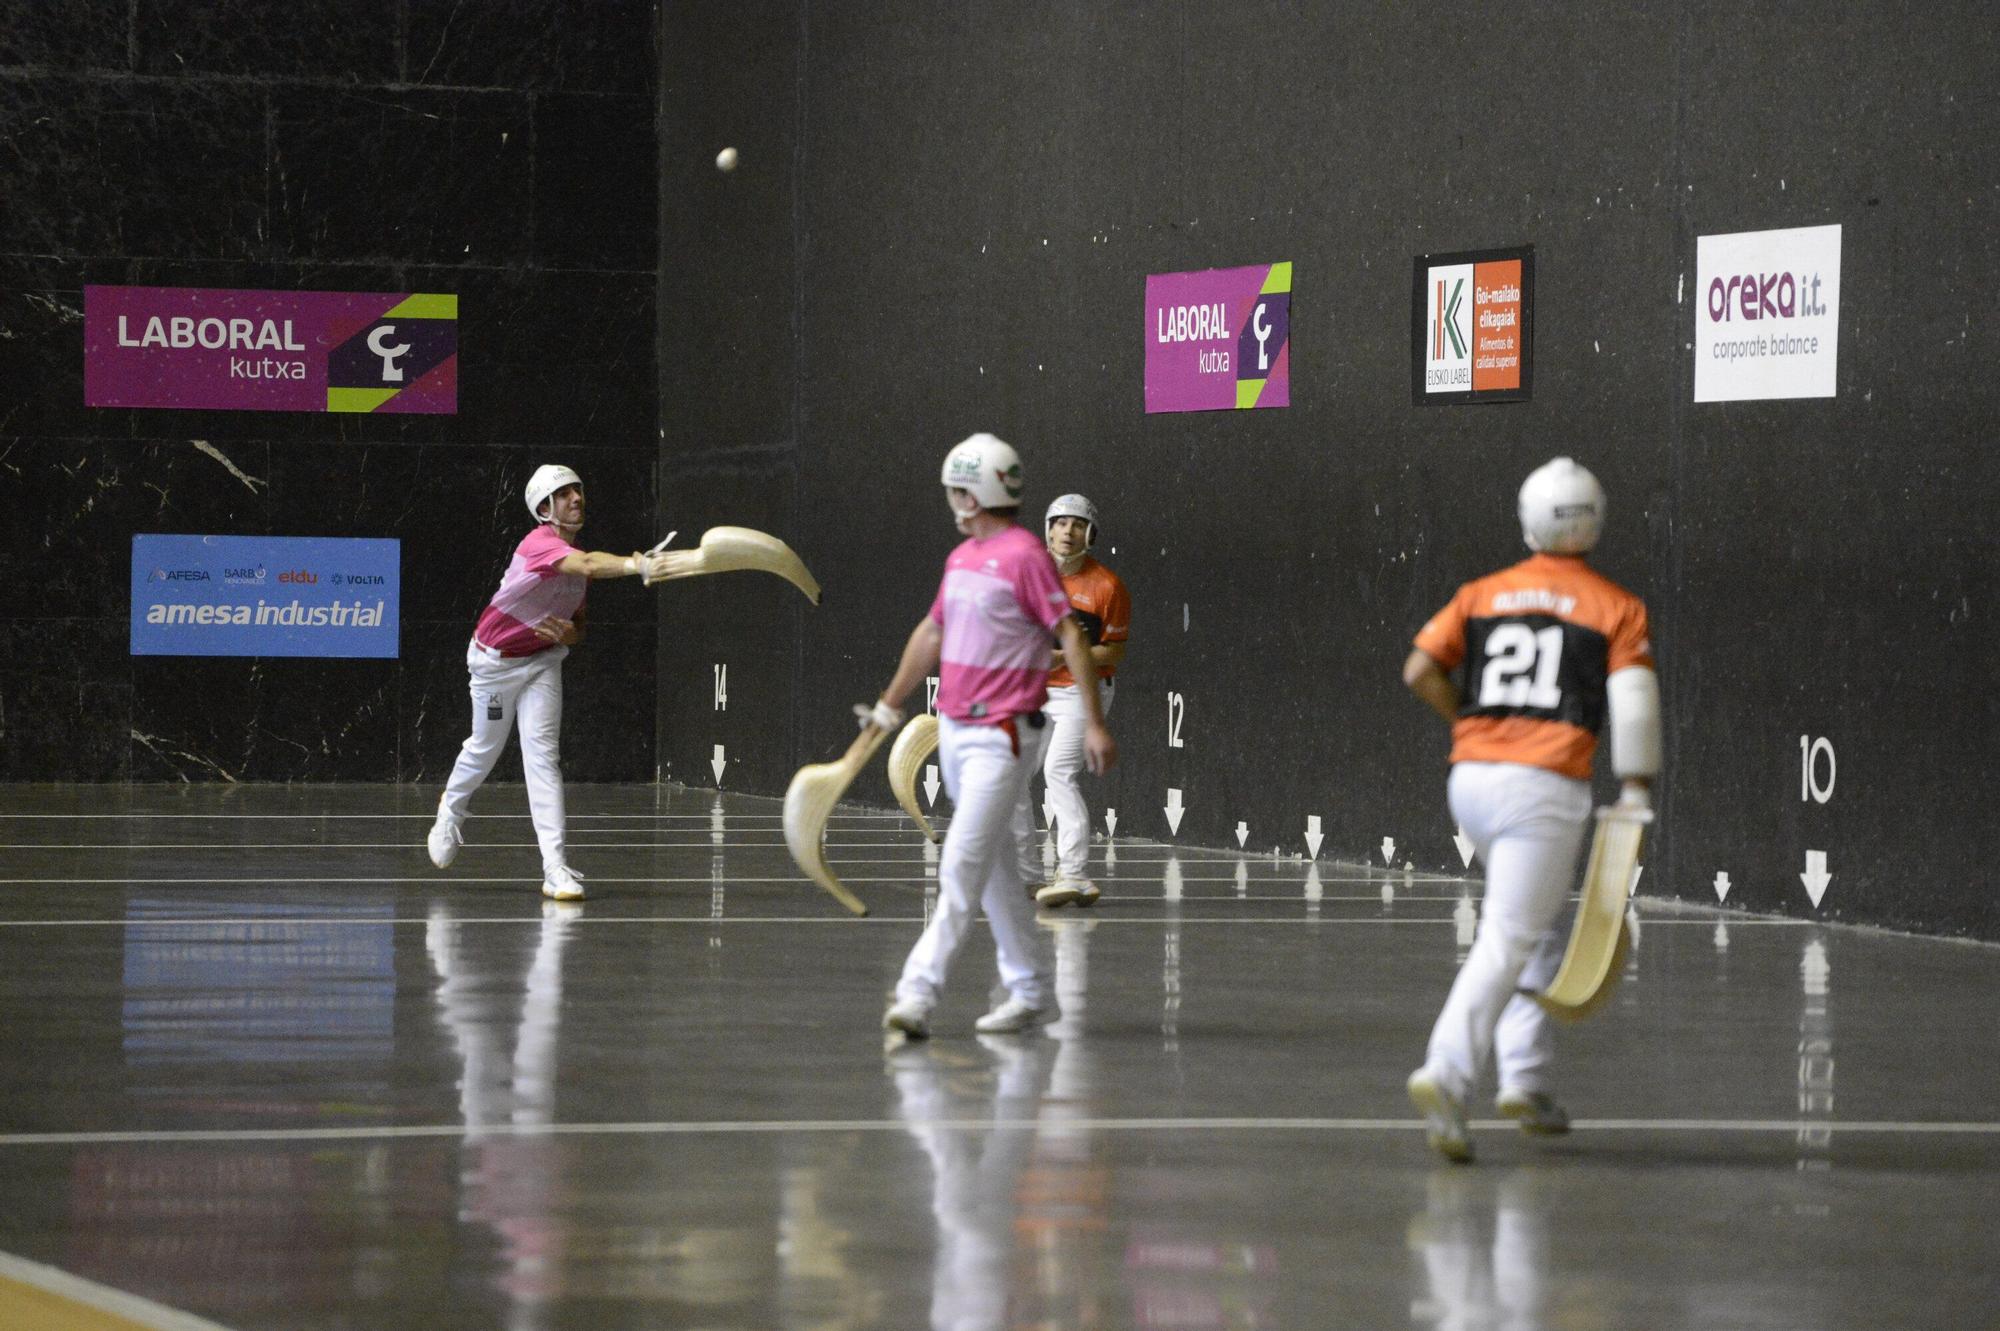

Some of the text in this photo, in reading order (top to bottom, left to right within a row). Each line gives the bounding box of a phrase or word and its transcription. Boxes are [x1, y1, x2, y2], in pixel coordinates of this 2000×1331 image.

[1477, 285, 1520, 304] Goi-mailako
[1158, 303, 1230, 343] LABORAL
[1480, 308, 1516, 331] elikagaiak
[118, 315, 305, 351] LABORAL
[1713, 333, 1818, 363] corporate balance
[230, 356, 306, 379] kutxa
[1199, 349, 1230, 373] kutxa
[1427, 367, 1470, 386] EUSKO LABEL
[166, 571, 211, 581] AFESA
[278, 569, 318, 584] eldu
[347, 574, 384, 585] VOLTIA
[147, 600, 384, 627] amesa industrial
[1479, 622, 1563, 710] 21
[714, 664, 728, 711] 14
[1168, 691, 1184, 748] 12
[1800, 734, 1836, 804] 10
